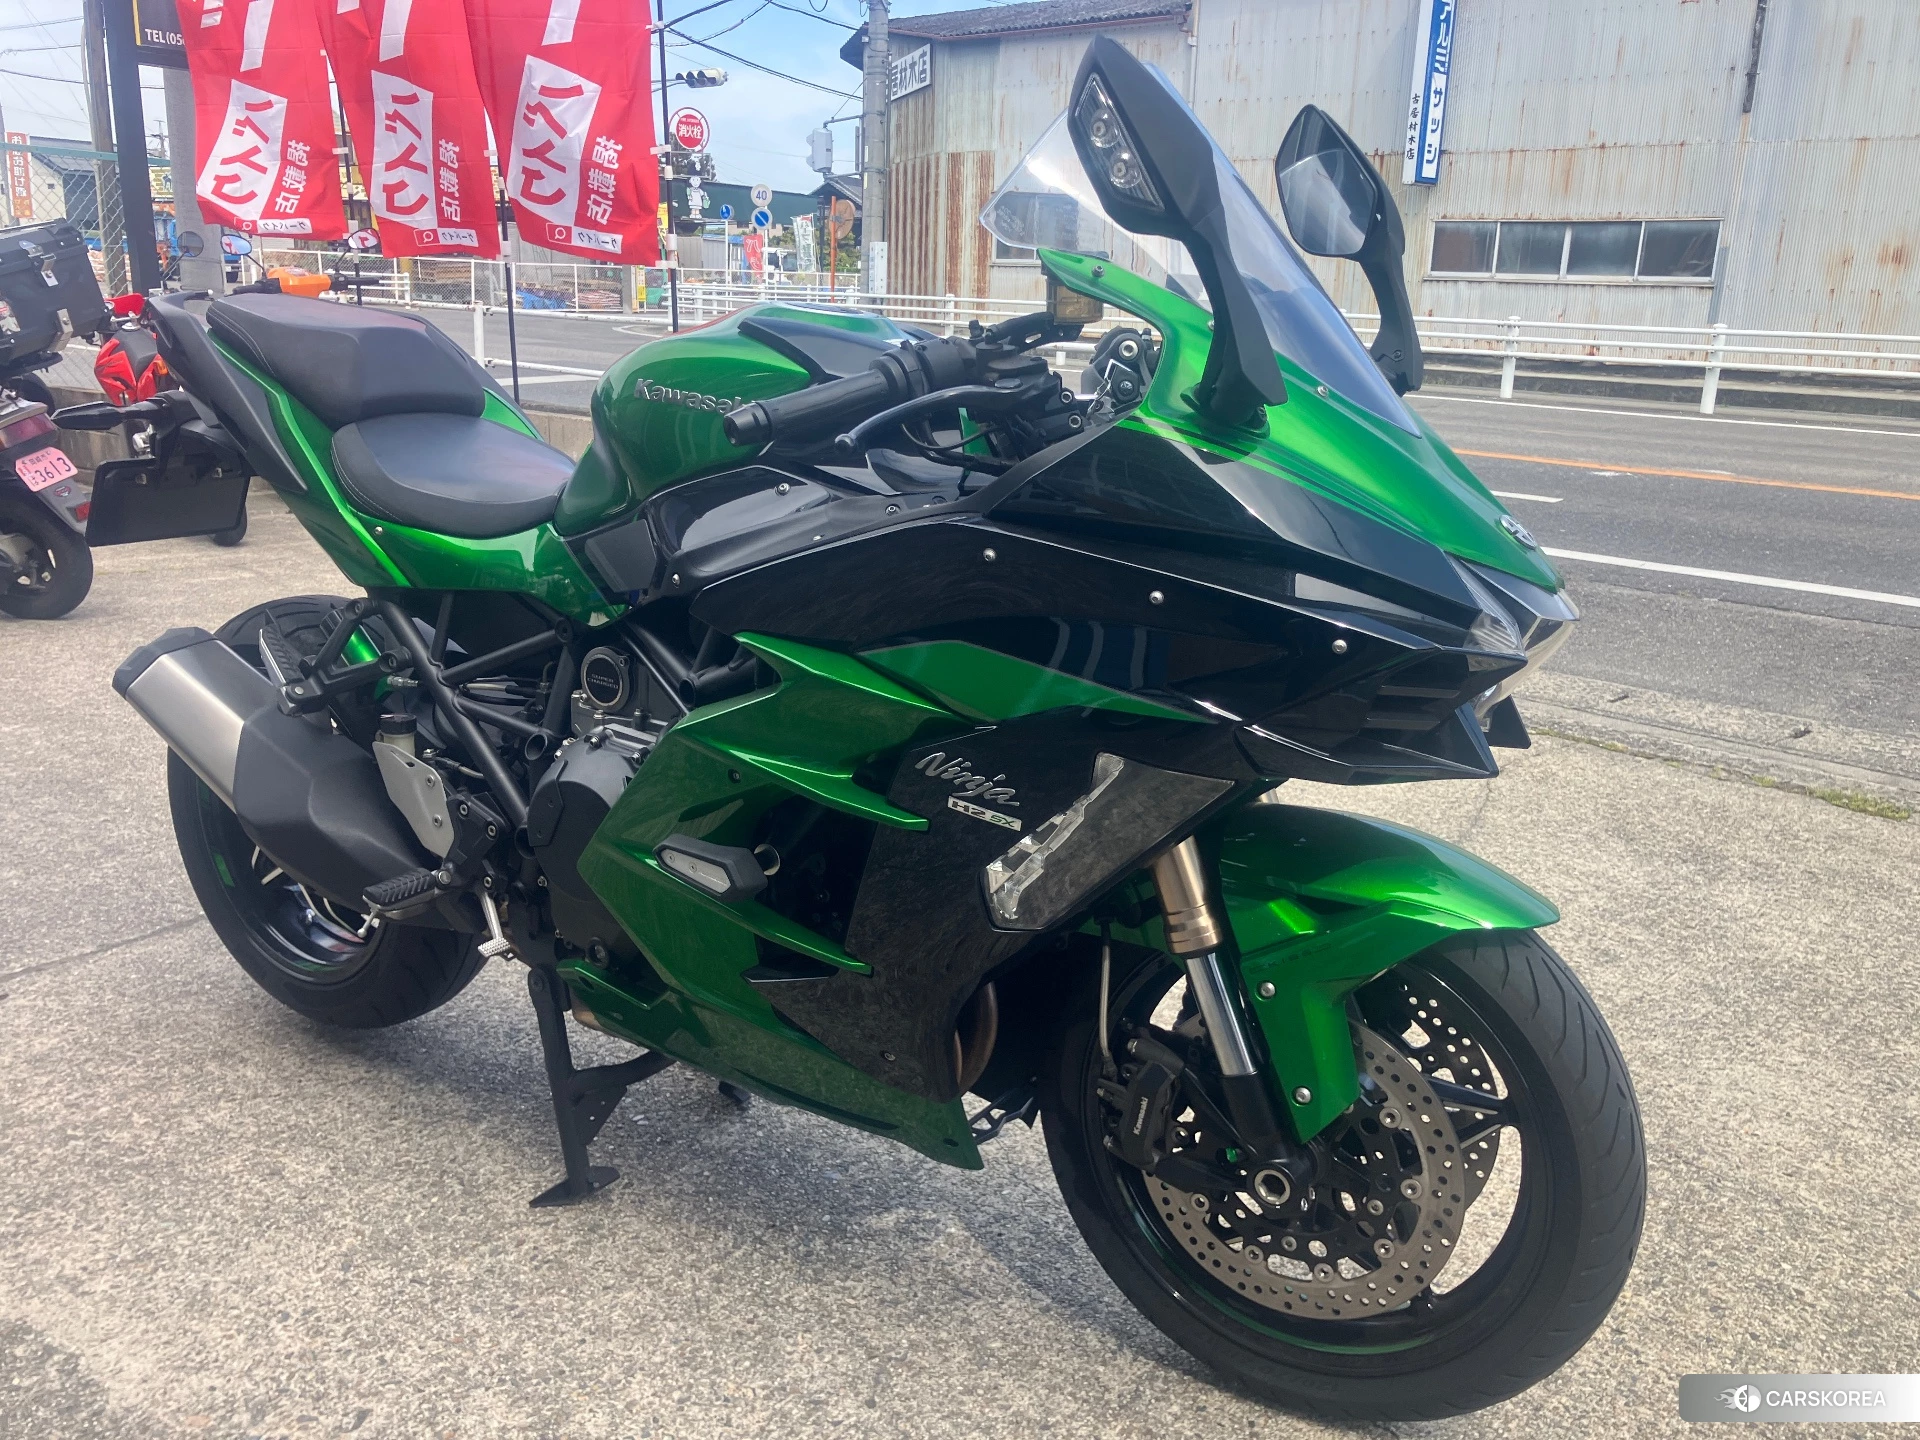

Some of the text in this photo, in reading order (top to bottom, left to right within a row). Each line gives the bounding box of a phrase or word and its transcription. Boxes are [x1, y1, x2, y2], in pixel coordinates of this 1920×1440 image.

[144, 28, 186, 46] TEL(05
[678, 123, 703, 139] 消火栓
[1406, 93, 1420, 160] 古居材木店
[755, 190, 767, 200] 40
[35, 457, 71, 482] 3613
[914, 752, 1020, 806] Ninja
[1133, 1096, 1148, 1135] Kawasaki
